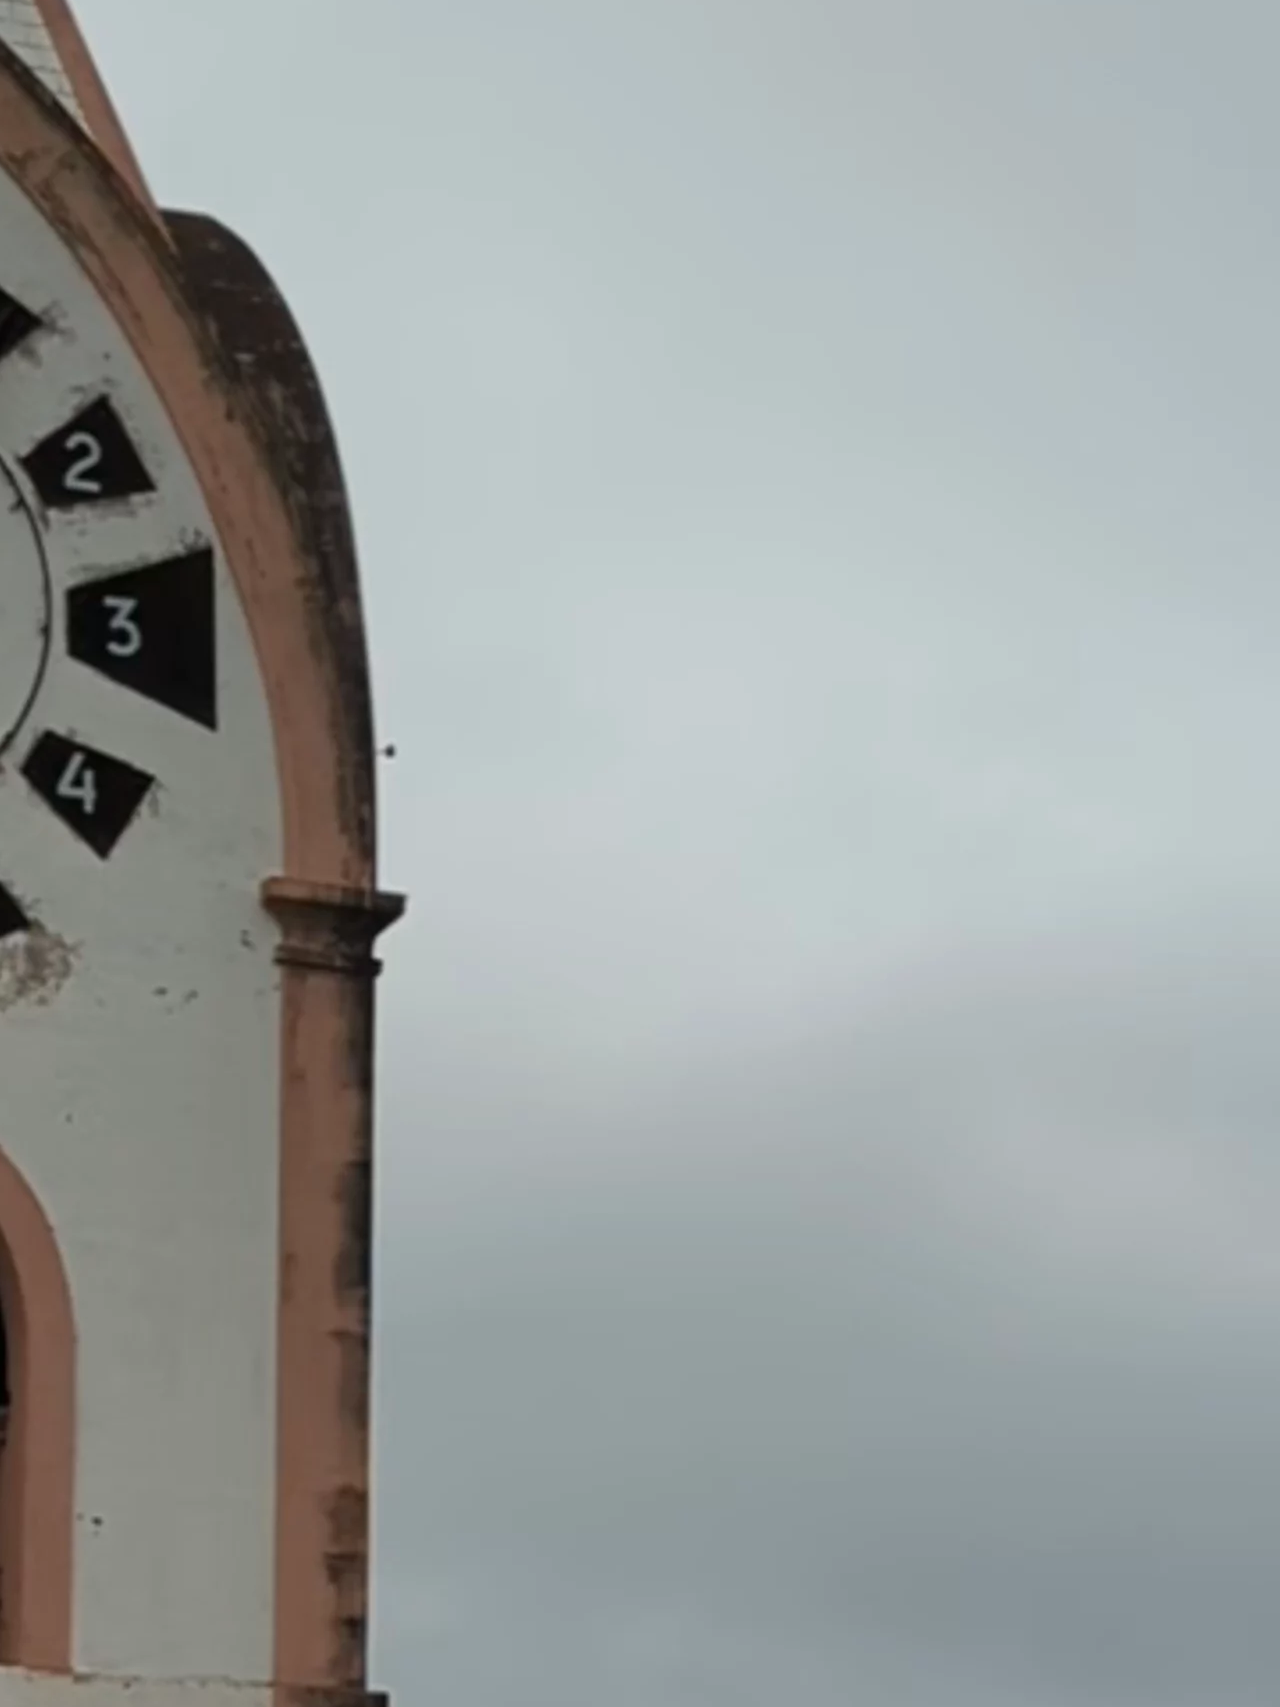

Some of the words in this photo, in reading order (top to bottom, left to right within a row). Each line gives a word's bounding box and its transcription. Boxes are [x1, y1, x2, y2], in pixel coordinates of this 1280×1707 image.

[63, 431, 103, 493] 2
[103, 595, 142, 657] 3
[55, 751, 97, 814] 4
